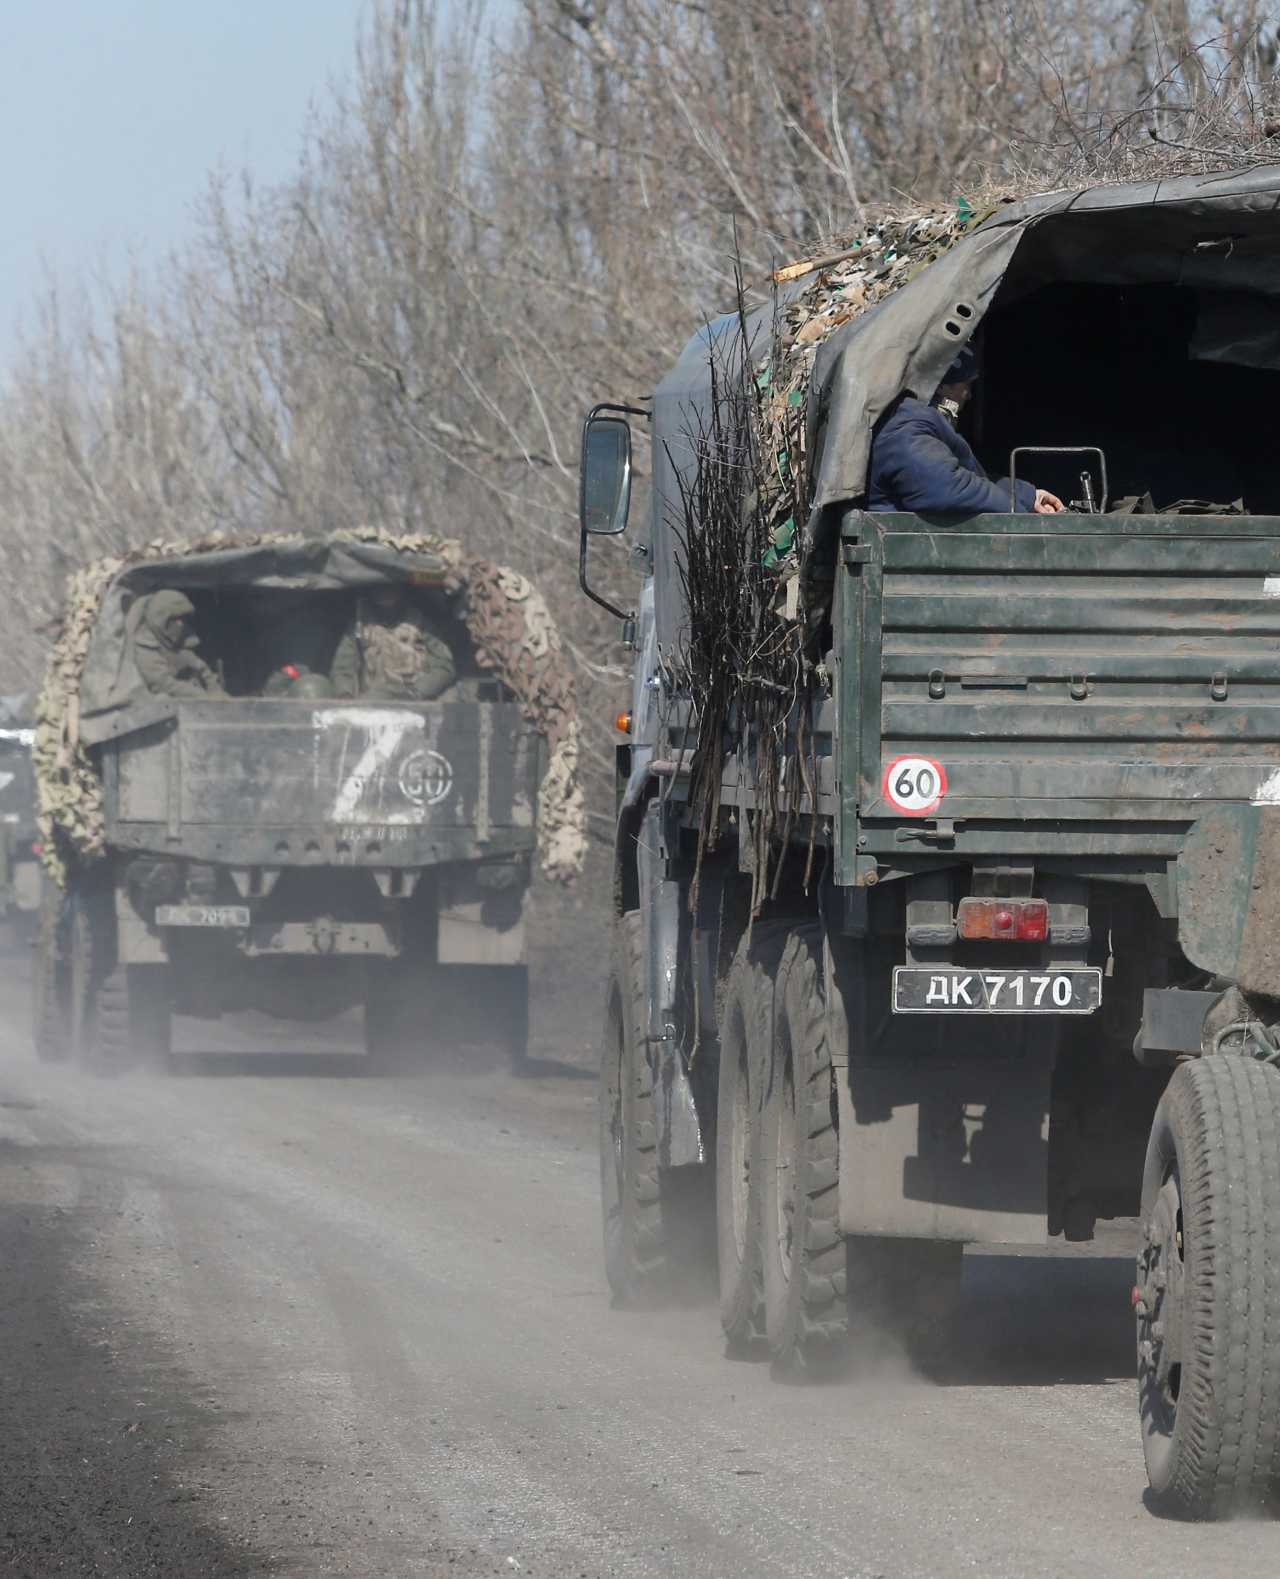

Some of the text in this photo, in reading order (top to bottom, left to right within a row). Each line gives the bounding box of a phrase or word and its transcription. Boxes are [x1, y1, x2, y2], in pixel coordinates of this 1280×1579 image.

[312, 708, 426, 824] Z
[895, 769, 935, 799] 60
[926, 975, 1073, 1006] ДК 7170
